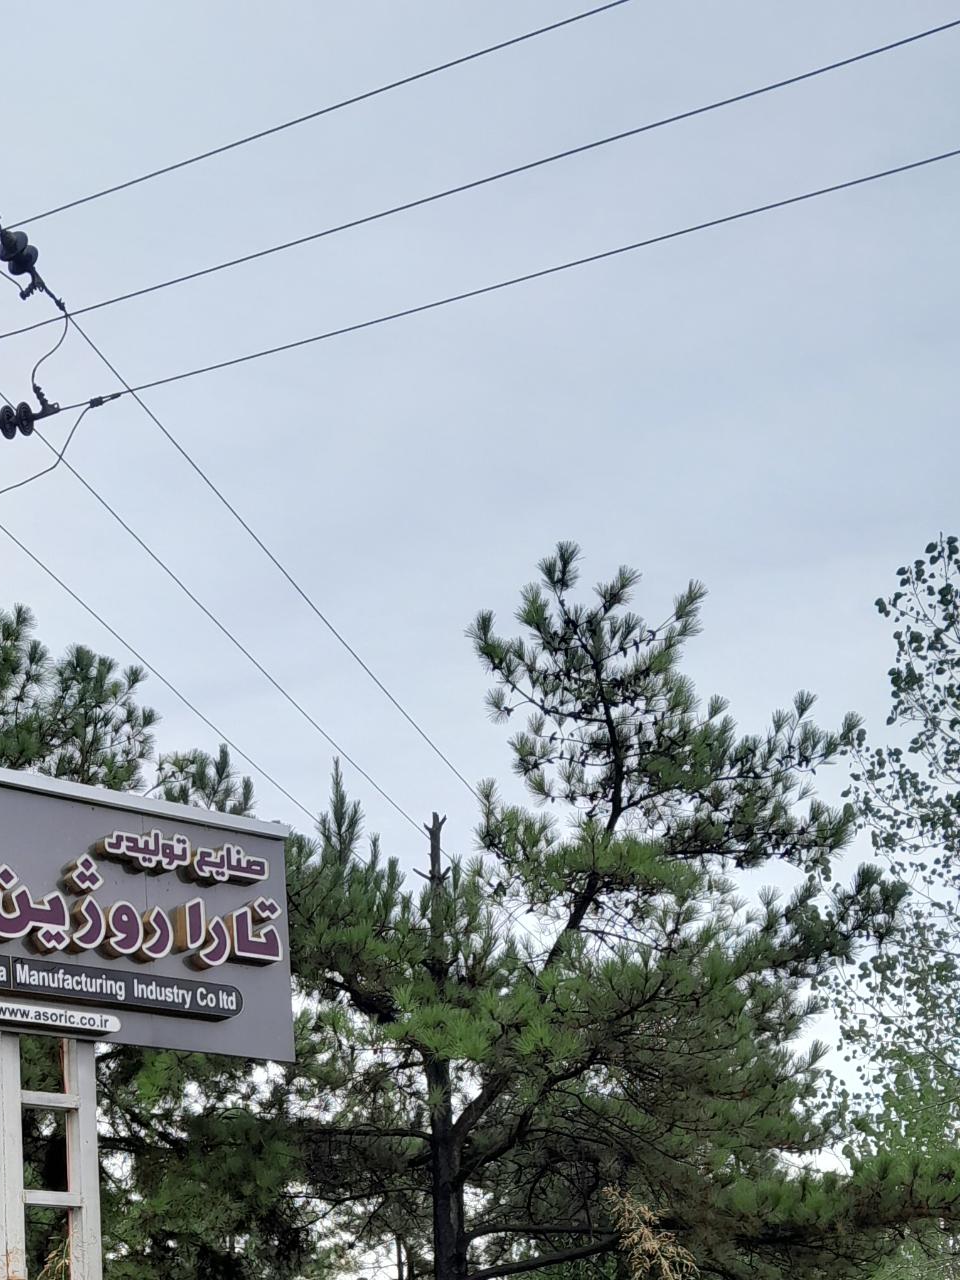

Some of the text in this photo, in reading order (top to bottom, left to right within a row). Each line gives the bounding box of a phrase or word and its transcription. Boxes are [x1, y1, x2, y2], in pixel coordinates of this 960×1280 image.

[106, 831, 267, 880] صنایع تولیدی
[186, 898, 282, 964] تارا
[15, 963, 126, 1000] Manufacturing
[133, 979, 192, 1008] Industry
[196, 987, 216, 1007] Co
[219, 990, 237, 1010] ltd
